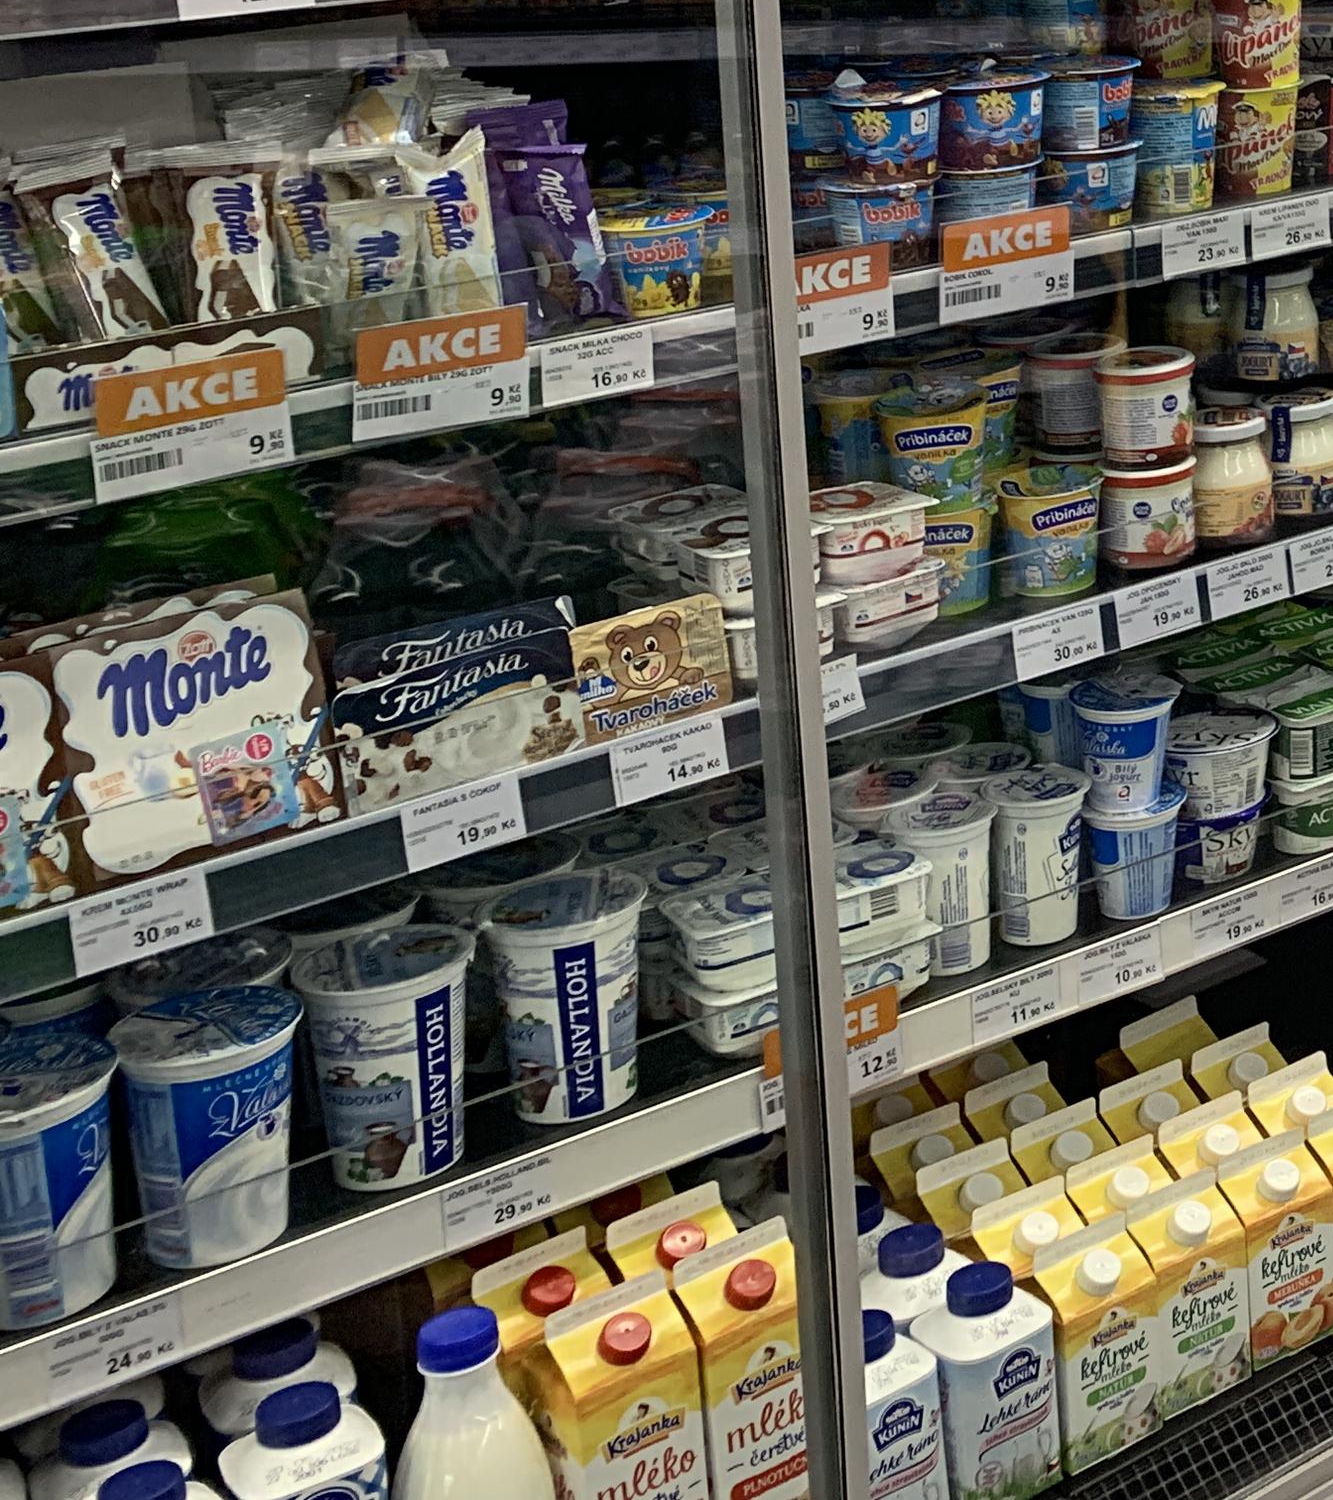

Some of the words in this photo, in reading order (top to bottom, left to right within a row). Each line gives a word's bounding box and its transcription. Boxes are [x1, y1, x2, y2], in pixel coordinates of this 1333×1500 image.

[213, 182, 261, 256] Monte
[425, 169, 476, 251] Monte
[537, 167, 576, 226] Milka
[862, 201, 922, 224] bobik
[76, 192, 136, 263] Monte
[625, 236, 689, 265] bobik
[962, 220, 1053, 262] AKCE
[381, 322, 501, 373] AKCE
[124, 366, 258, 423] AKCE
[632, 368, 647, 381] Kč
[897, 427, 970, 449] Pribináček
[377, 617, 533, 679] Fantasia
[97, 625, 272, 739] Monte
[374, 649, 531, 723] Fantasia
[589, 680, 718, 734] Tvaroháček
[706, 758, 721, 770] Kč
[501, 818, 517, 831] Kč
[185, 917, 203, 931] Kč
[564, 957, 596, 1105] HOLLANDIA
[425, 1003, 450, 1160] HOLLANDIA
[1261, 1236, 1327, 1285] kefírové
[1271, 1224, 1314, 1250] Krajanka
[1171, 1281, 1238, 1330] kefírové
[1182, 1269, 1226, 1297] Krajanka
[1080, 1330, 1150, 1382] kefírové
[1091, 1320, 1135, 1348] Krajanka
[606, 1413, 681, 1460] Krajanka
